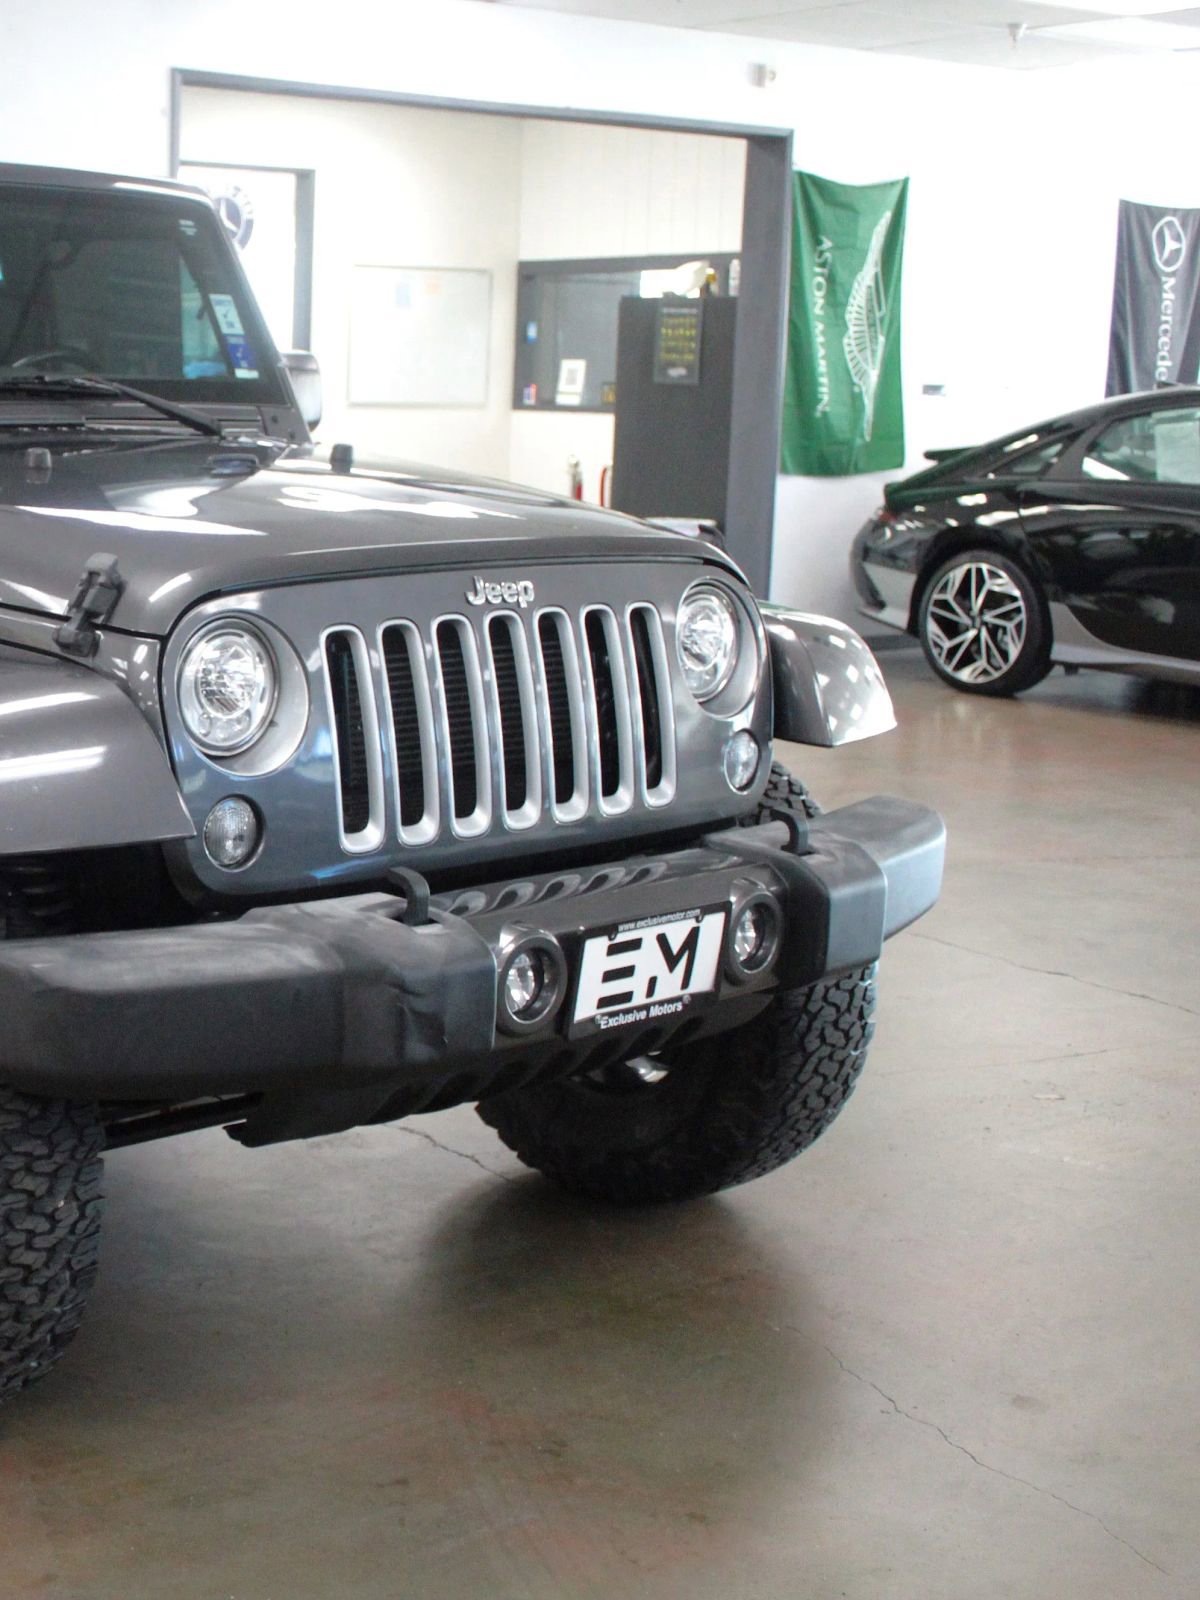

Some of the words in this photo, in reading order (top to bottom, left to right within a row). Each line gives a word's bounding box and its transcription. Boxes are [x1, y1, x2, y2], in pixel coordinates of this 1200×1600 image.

[812, 235, 833, 316] ASTON
[813, 320, 831, 412] MARTIN
[1154, 276, 1177, 386] Mercede
[464, 575, 535, 608] Jeep
[596, 925, 701, 1010] EM
[600, 1009, 647, 1030] Exclusive
[648, 1001, 683, 1018] Motors
